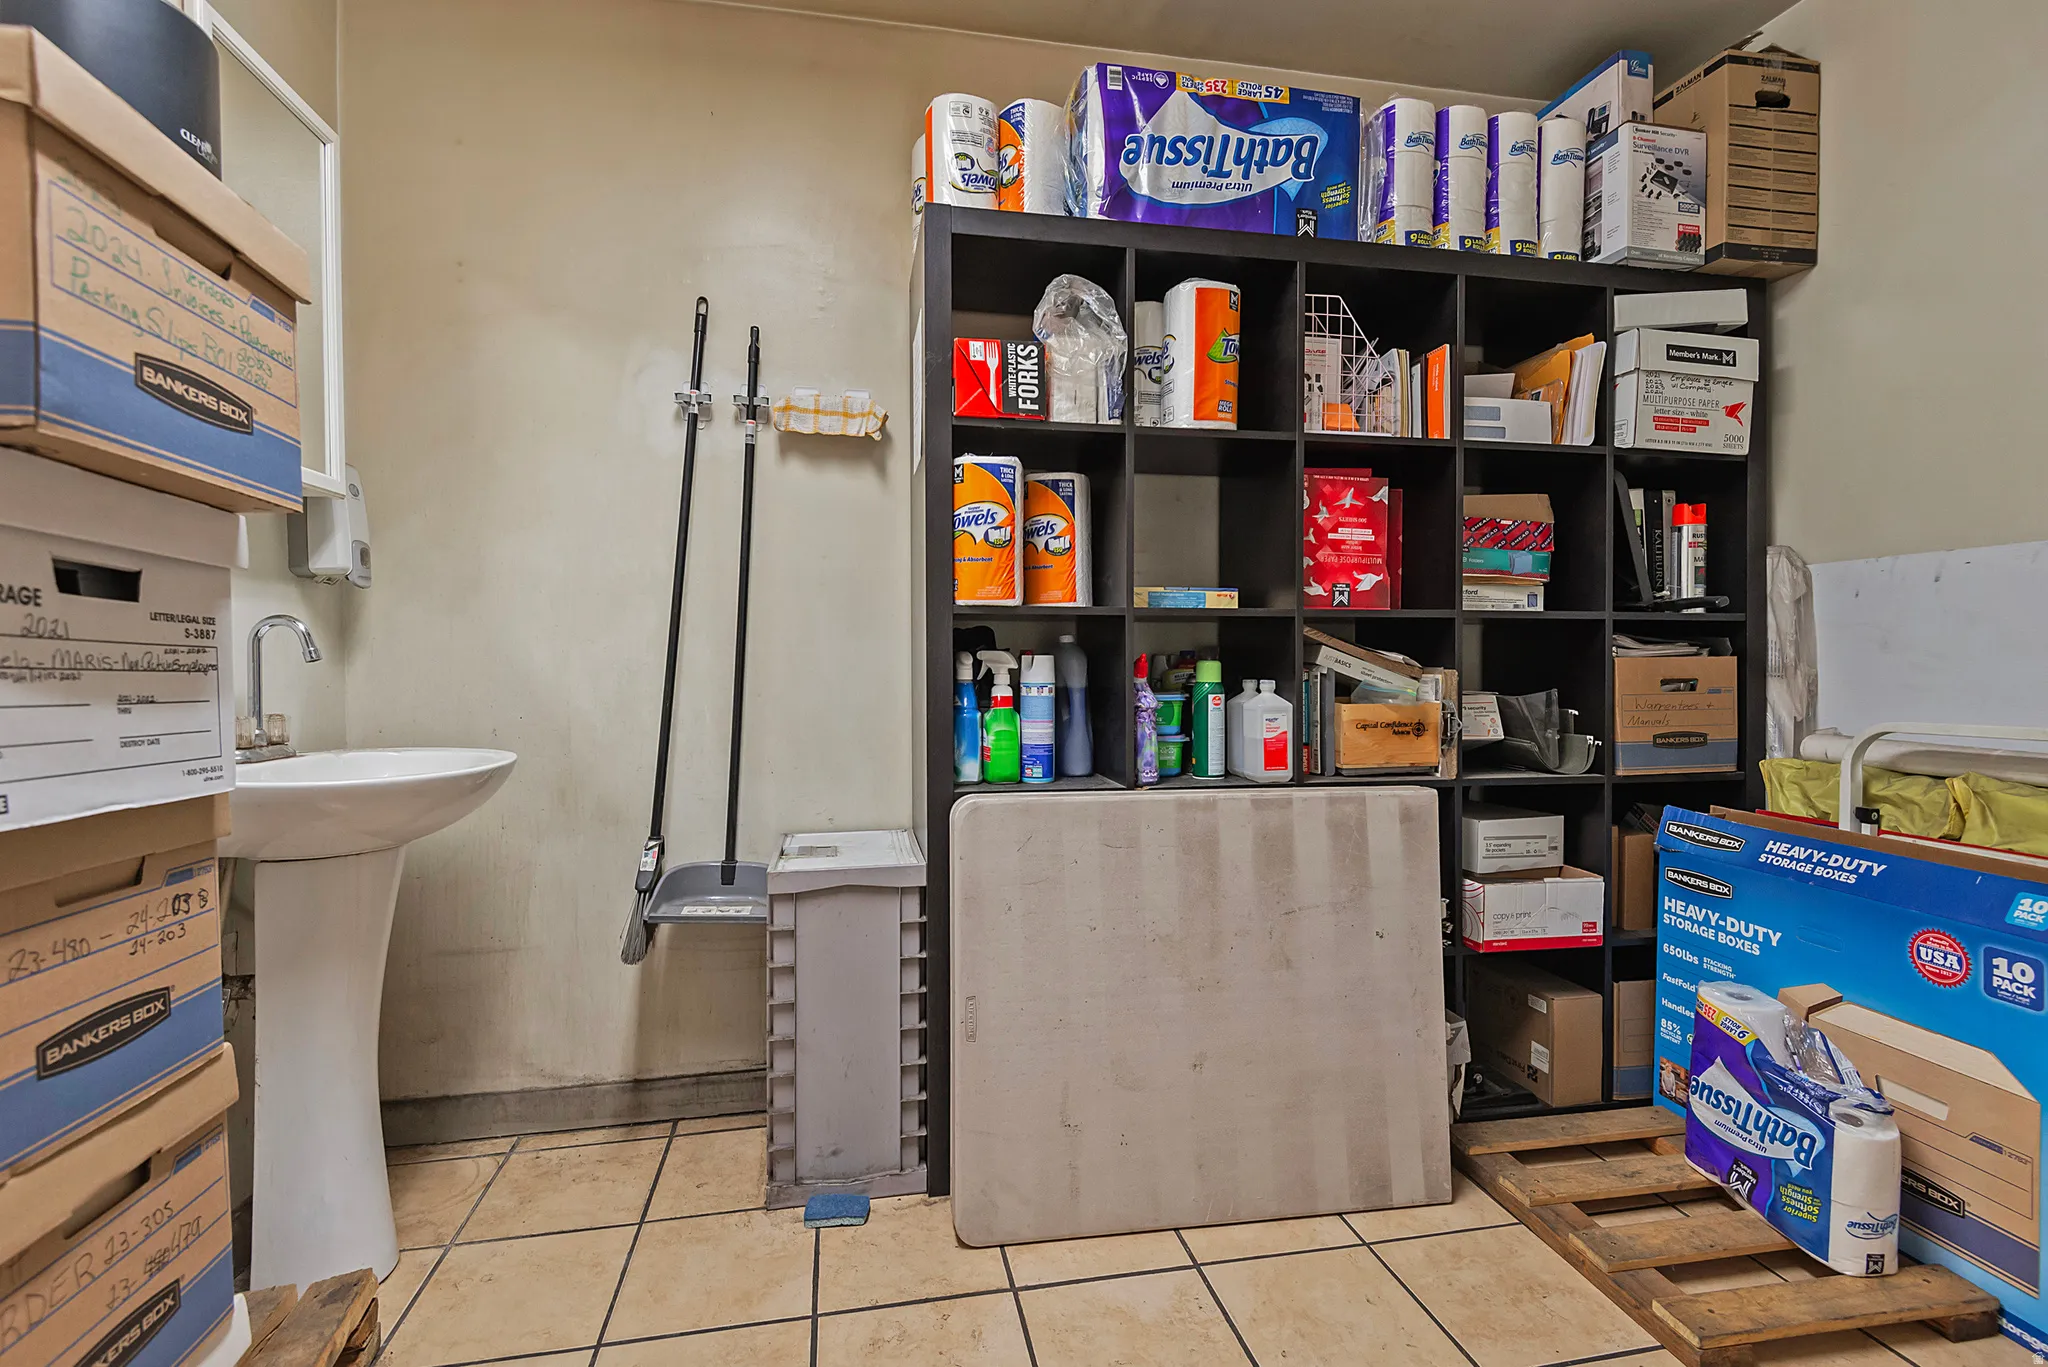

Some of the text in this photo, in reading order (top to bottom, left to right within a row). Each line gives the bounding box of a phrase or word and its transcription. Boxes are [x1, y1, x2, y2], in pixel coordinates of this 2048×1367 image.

[1205, 79, 1228, 93] 235
[1676, 72, 1702, 94] ZALMAN
[1237, 88, 1263, 98] LARGE
[1263, 85, 1285, 99] 45
[1633, 141, 1673, 154] Surveillance
[1674, 147, 1690, 156] DVR
[1123, 134, 1320, 181] BathTissue
[1172, 180, 1253, 192] Ultra Premium
[1321, 192, 1350, 204] Softness
[1324, 199, 1350, 209] Superior
[1410, 234, 1417, 242] 9
[1464, 238, 1472, 248] 9
[1515, 242, 1522, 252] 9
[1669, 349, 1700, 360] Member's
[1007, 343, 1017, 398] WHITE PLASTIC
[1017, 344, 1039, 411] FORKS
[142, 365, 249, 425] BANKERS BOX
[1642, 394, 1720, 409] MULTIPURPOSE PAPER
[1654, 407, 1670, 416] letter
[1690, 409, 1709, 419] white
[1723, 433, 1745, 444] 5000
[1000, 466, 1014, 475] THICK
[1479, 528, 1499, 544] SMEAD
[1510, 530, 1530, 546] SMEAD
[1320, 554, 1382, 565] MULTIPURPOSE PAPER
[1655, 529, 1663, 588] KALIBURN
[150, 612, 216, 626] LETTER/LEGAL SIZE
[184, 628, 217, 640] S-3887
[1355, 721, 1413, 732] Capital Confidence
[1627, 713, 1671, 726] Manuals
[120, 738, 161, 748] DESTROY DATE
[1668, 824, 1742, 849] BANKERS BOX
[1764, 840, 1887, 877] HEAVY-DUTY
[1758, 853, 1858, 884] STORAGE BOXES
[1667, 870, 1730, 895] BANKERS BOX
[2018, 898, 2048, 915] 10
[1492, 911, 1532, 921] copy print
[1664, 895, 1782, 947] HEAVY-DUTY
[2013, 909, 2047, 924] PACK
[1663, 913, 1760, 956] STORAGE BOXES
[1662, 943, 1733, 972] 650lbs STACKING
[1919, 947, 1961, 970] USA
[1925, 965, 1940, 974] Since
[1992, 957, 2035, 984] 10
[1992, 976, 2037, 999] PACK
[1661, 997, 1695, 1019] Handles
[1703, 1003, 1717, 1021] 235
[46, 997, 165, 1066] BANKERS BOX
[1660, 1018, 1682, 1036] 85%
[1660, 1027, 1682, 1041] RECYCLED
[1719, 1020, 1738, 1036] LARGE
[1737, 1030, 1750, 1040] 9
[1660, 1032, 1681, 1045] CONTENT
[1690, 1076, 1818, 1170] BathTissue
[1714, 1119, 1768, 1154] Ultra Premium
[1732, 1164, 1757, 1184] Member's
[1779, 1185, 1813, 1205] Strength
[1927, 1189, 1960, 1210] BOX
[1781, 1195, 1820, 1215] Softness
[1783, 1205, 1818, 1222] Superior
[142, 1291, 176, 1333] BOX
